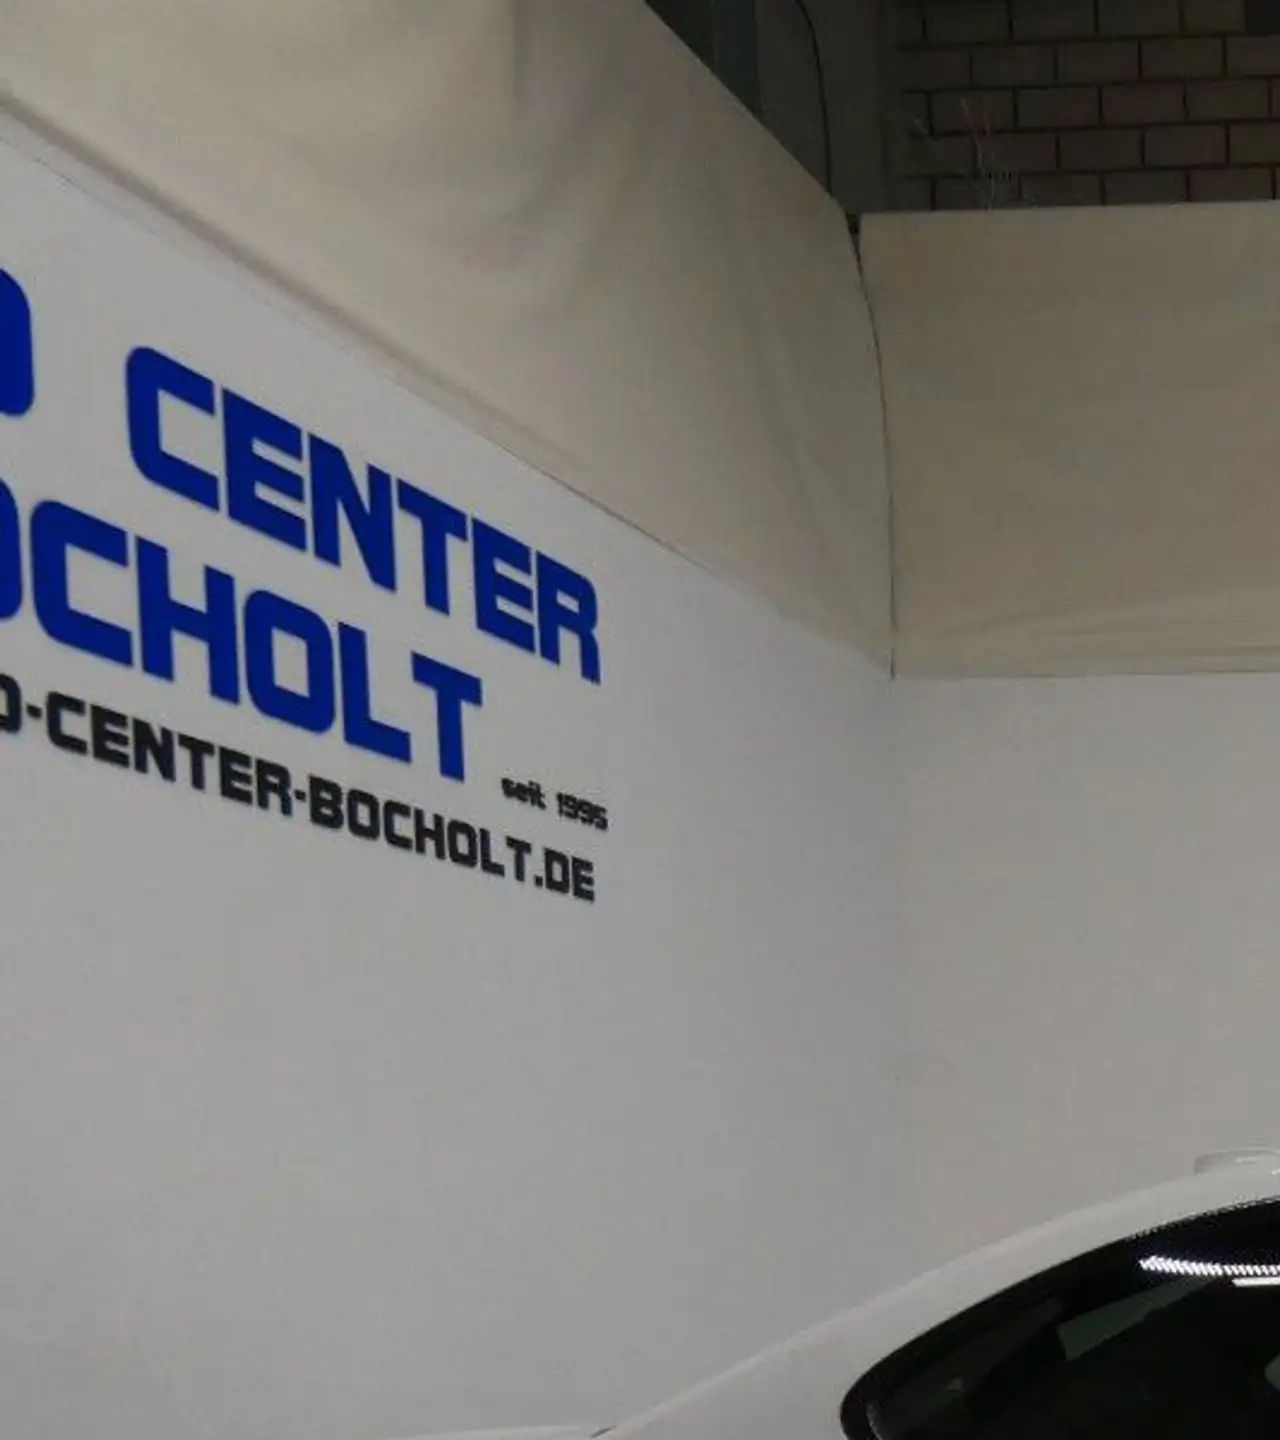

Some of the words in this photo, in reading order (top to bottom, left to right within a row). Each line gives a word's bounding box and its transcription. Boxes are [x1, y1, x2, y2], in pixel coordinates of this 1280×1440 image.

[0, 478, 483, 783] CHOLT
[501, 777, 547, 811] seit
[555, 791, 609, 832] 1995
[125, 346, 601, 685] CENTER
